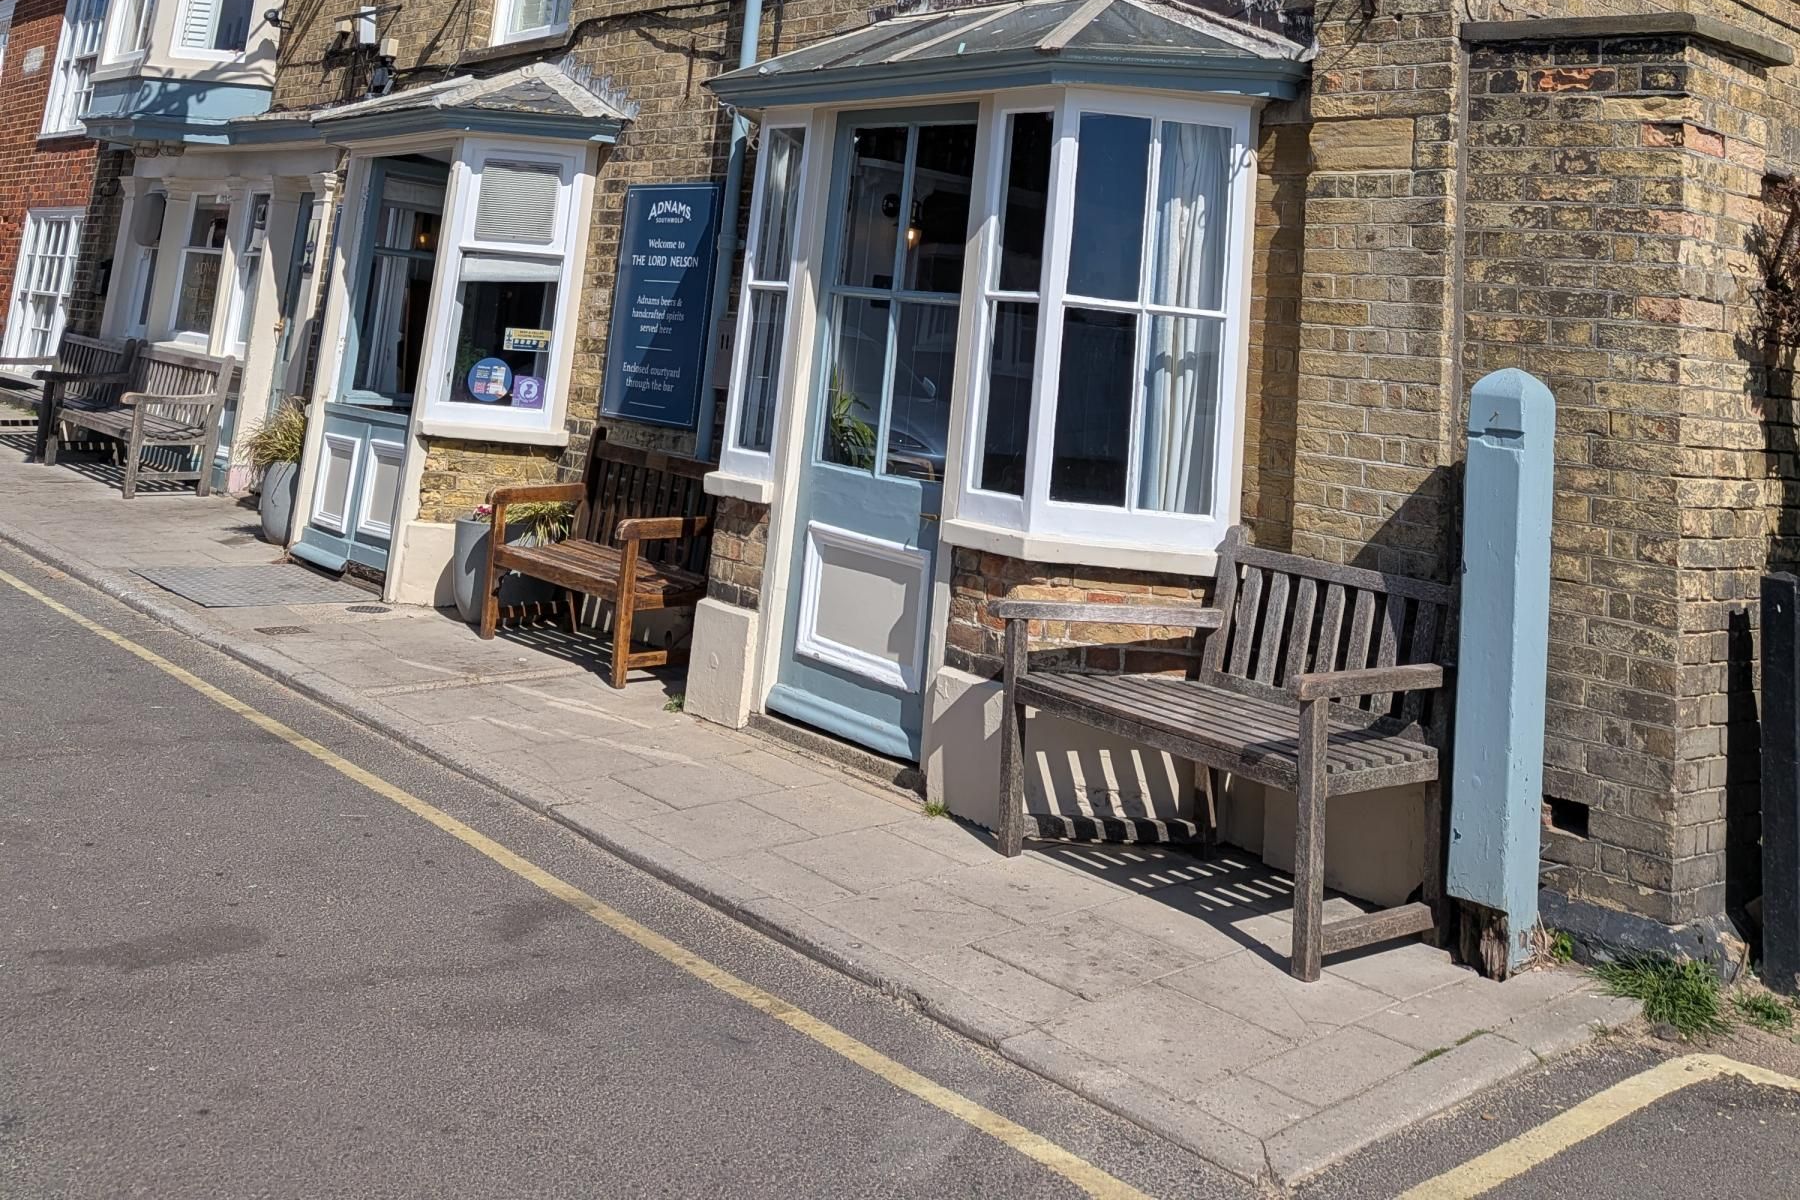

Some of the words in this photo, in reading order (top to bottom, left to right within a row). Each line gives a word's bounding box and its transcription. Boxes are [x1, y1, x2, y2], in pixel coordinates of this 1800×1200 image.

[655, 216, 684, 224] SOUTHWOLD
[648, 238, 677, 249] Welcome
[678, 240, 686, 249] to
[632, 254, 646, 267] THE
[648, 255, 668, 267] LORD
[670, 256, 699, 268] NELSON
[636, 295, 660, 306] Adnams
[660, 296, 676, 307] beers
[676, 298, 683, 307] &
[631, 307, 665, 320] handcrafted
[665, 311, 685, 323] spirits
[639, 322, 659, 333] served
[659, 324, 673, 334] here
[622, 361, 650, 375] Enclosed
[650, 365, 681, 379] courtyard
[625, 376, 650, 392] through
[651, 379, 662, 391] the
[662, 380, 675, 392] bar
